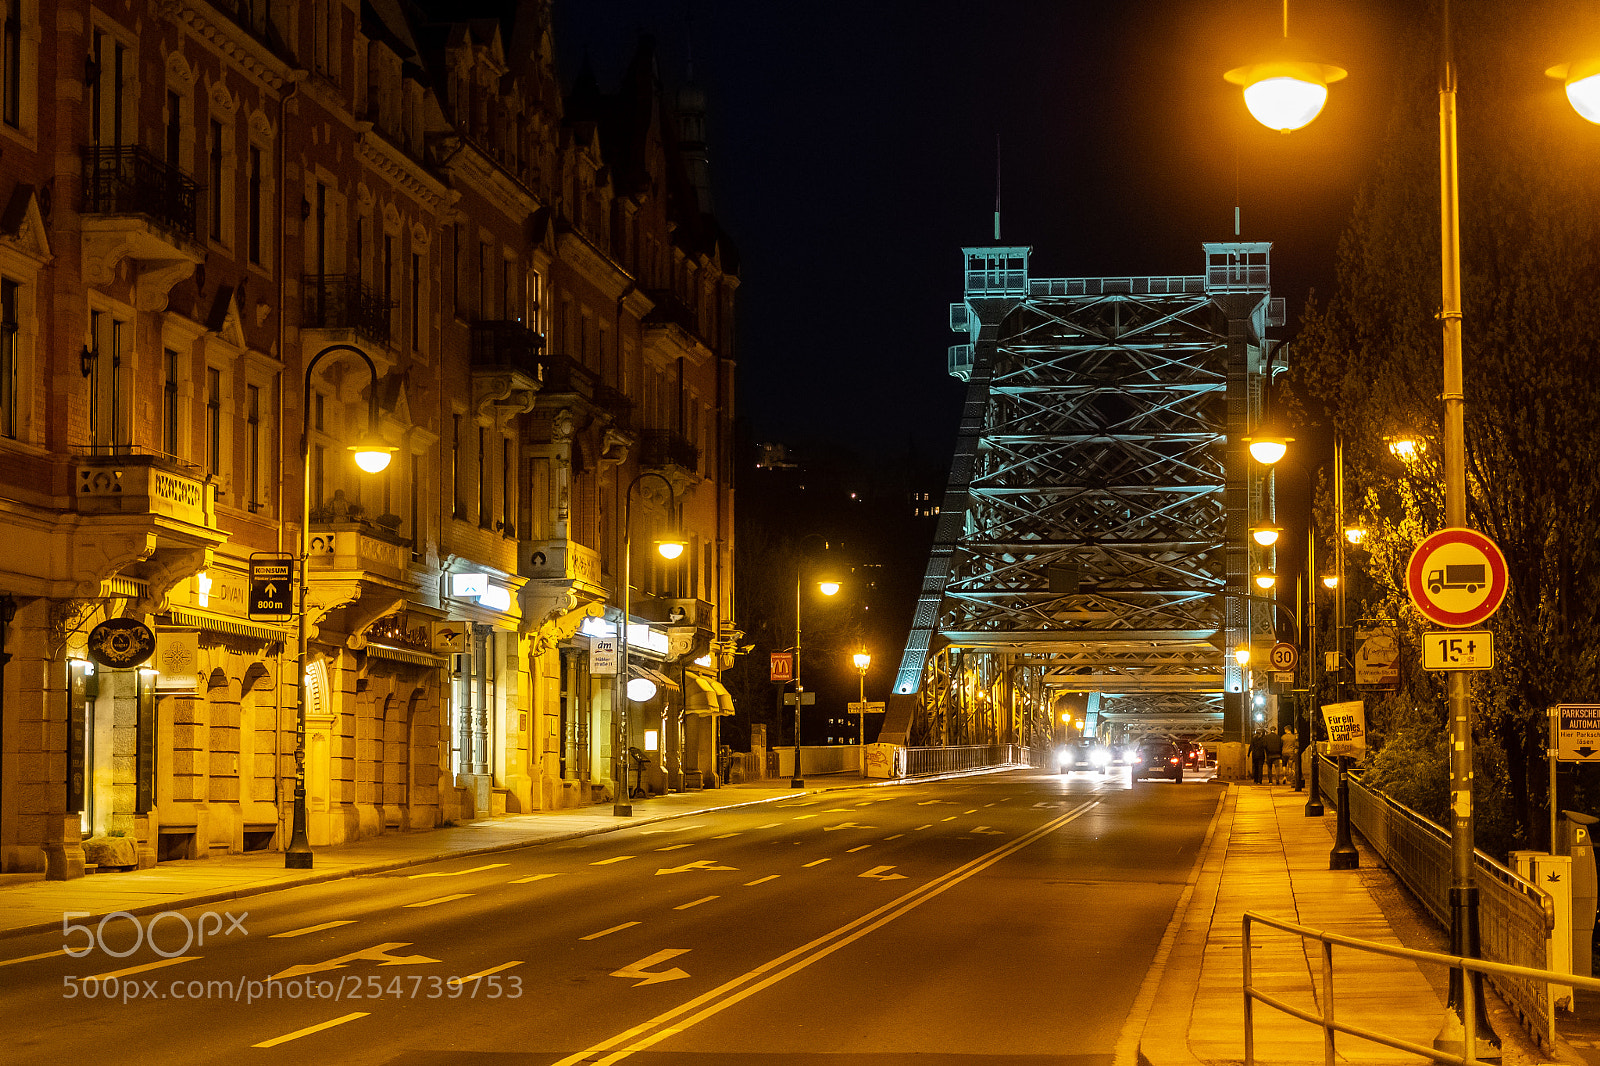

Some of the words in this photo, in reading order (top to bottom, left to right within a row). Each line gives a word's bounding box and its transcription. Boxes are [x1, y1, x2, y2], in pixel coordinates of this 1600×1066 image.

[221, 584, 244, 604] DIVAN
[257, 600, 273, 609] 800
[597, 640, 612, 649] dm
[1275, 650, 1292, 664] 30
[1561, 708, 1600, 718] PARKSCHEI
[1328, 715, 1341, 725] Für
[1341, 714, 1354, 723] ein
[1569, 719, 1600, 729] AUTOMAT
[1330, 723, 1361, 733] soziales
[1331, 732, 1353, 742] Land.
[1576, 828, 1586, 844] P
